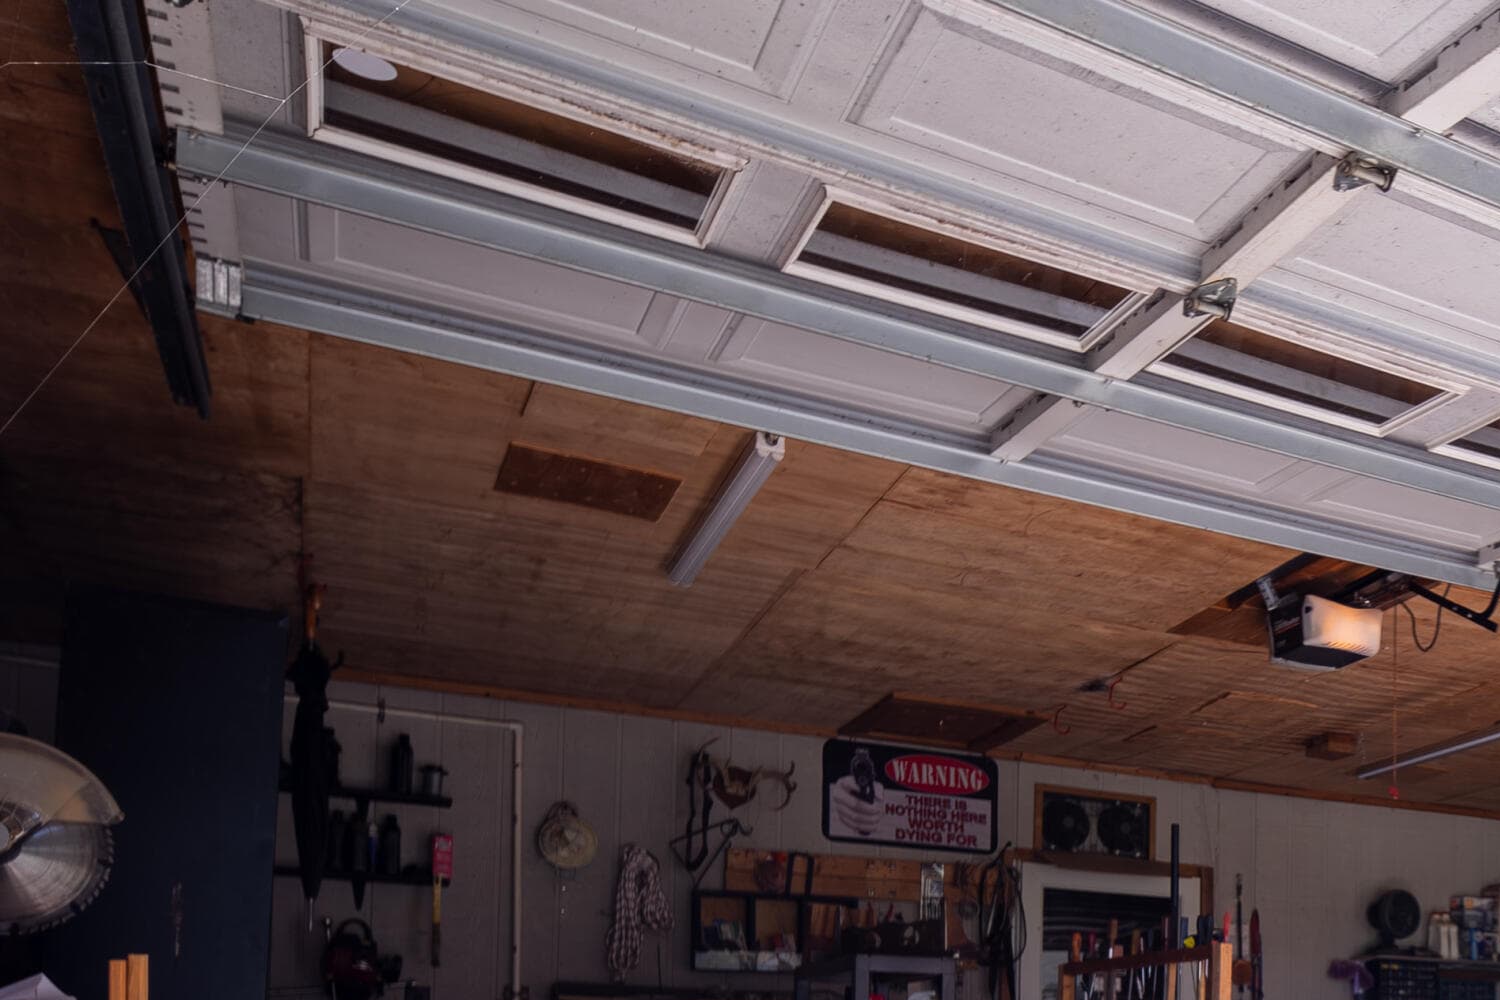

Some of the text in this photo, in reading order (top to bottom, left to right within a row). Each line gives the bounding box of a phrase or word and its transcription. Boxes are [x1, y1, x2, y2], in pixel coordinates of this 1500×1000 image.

[892, 760, 983, 791] WARNING
[906, 794, 968, 811] THERE IS
[885, 803, 987, 825] NOTHING HERE
[909, 818, 964, 833] WORTH
[895, 829, 978, 847] DYING FOR
